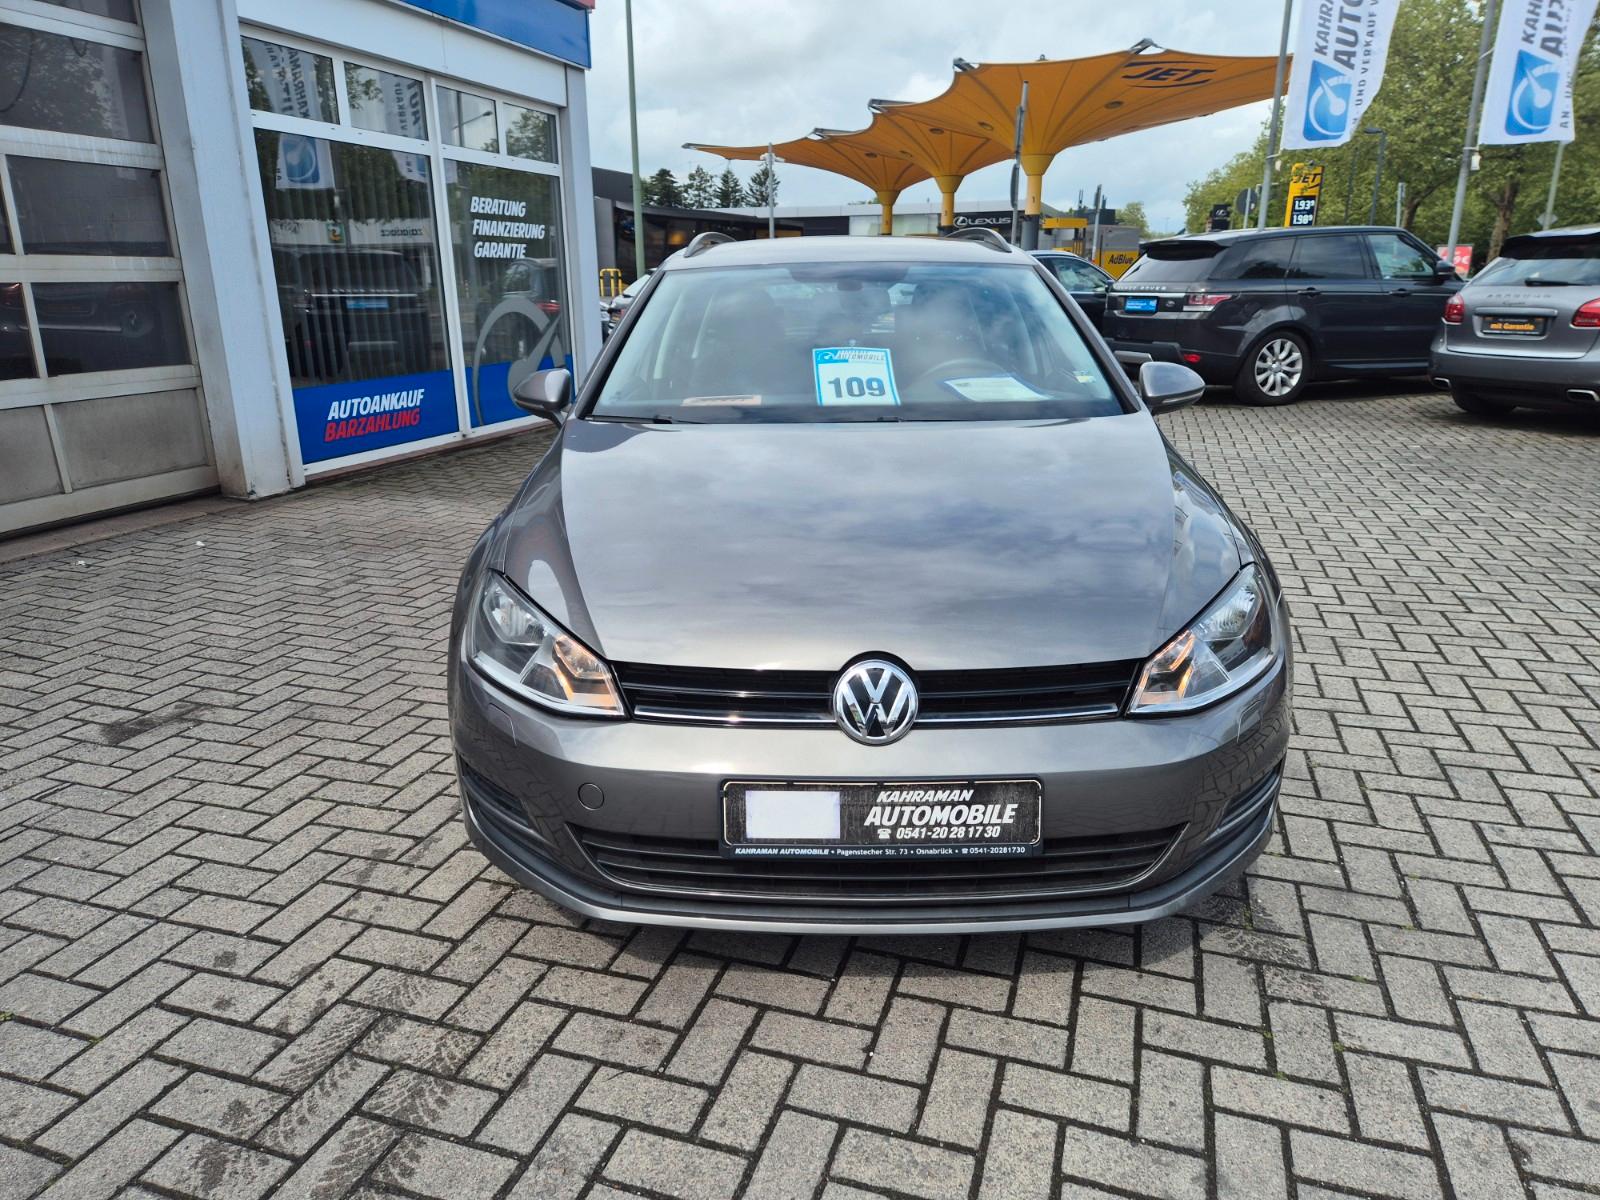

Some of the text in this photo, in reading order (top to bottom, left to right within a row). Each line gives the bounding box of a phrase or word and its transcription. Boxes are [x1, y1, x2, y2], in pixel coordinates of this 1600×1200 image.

[1521, 0, 1543, 45] KAH
[1361, 11, 1378, 75] VERKAUF
[1121, 66, 1217, 82] JET
[470, 196, 526, 217] BERATUNG
[472, 219, 545, 239] FINANZIERUNG
[968, 217, 1011, 225] LEXUS
[474, 241, 526, 259] GARANTIE
[1108, 254, 1134, 265] AdBlue
[828, 377, 886, 398] 109
[327, 389, 425, 421] AUTOANKAUF
[325, 408, 420, 442] BARZAHLUNG
[876, 790, 975, 803] KAHRAMAN
[864, 804, 1018, 826] AUTOMOBILE
[896, 826, 1001, 839] 0541-20 28 17 30
[836, 848, 883, 856] Pagenstecher
[916, 847, 953, 855] Osnabrück
[969, 846, 1026, 854] 0541-20281730
